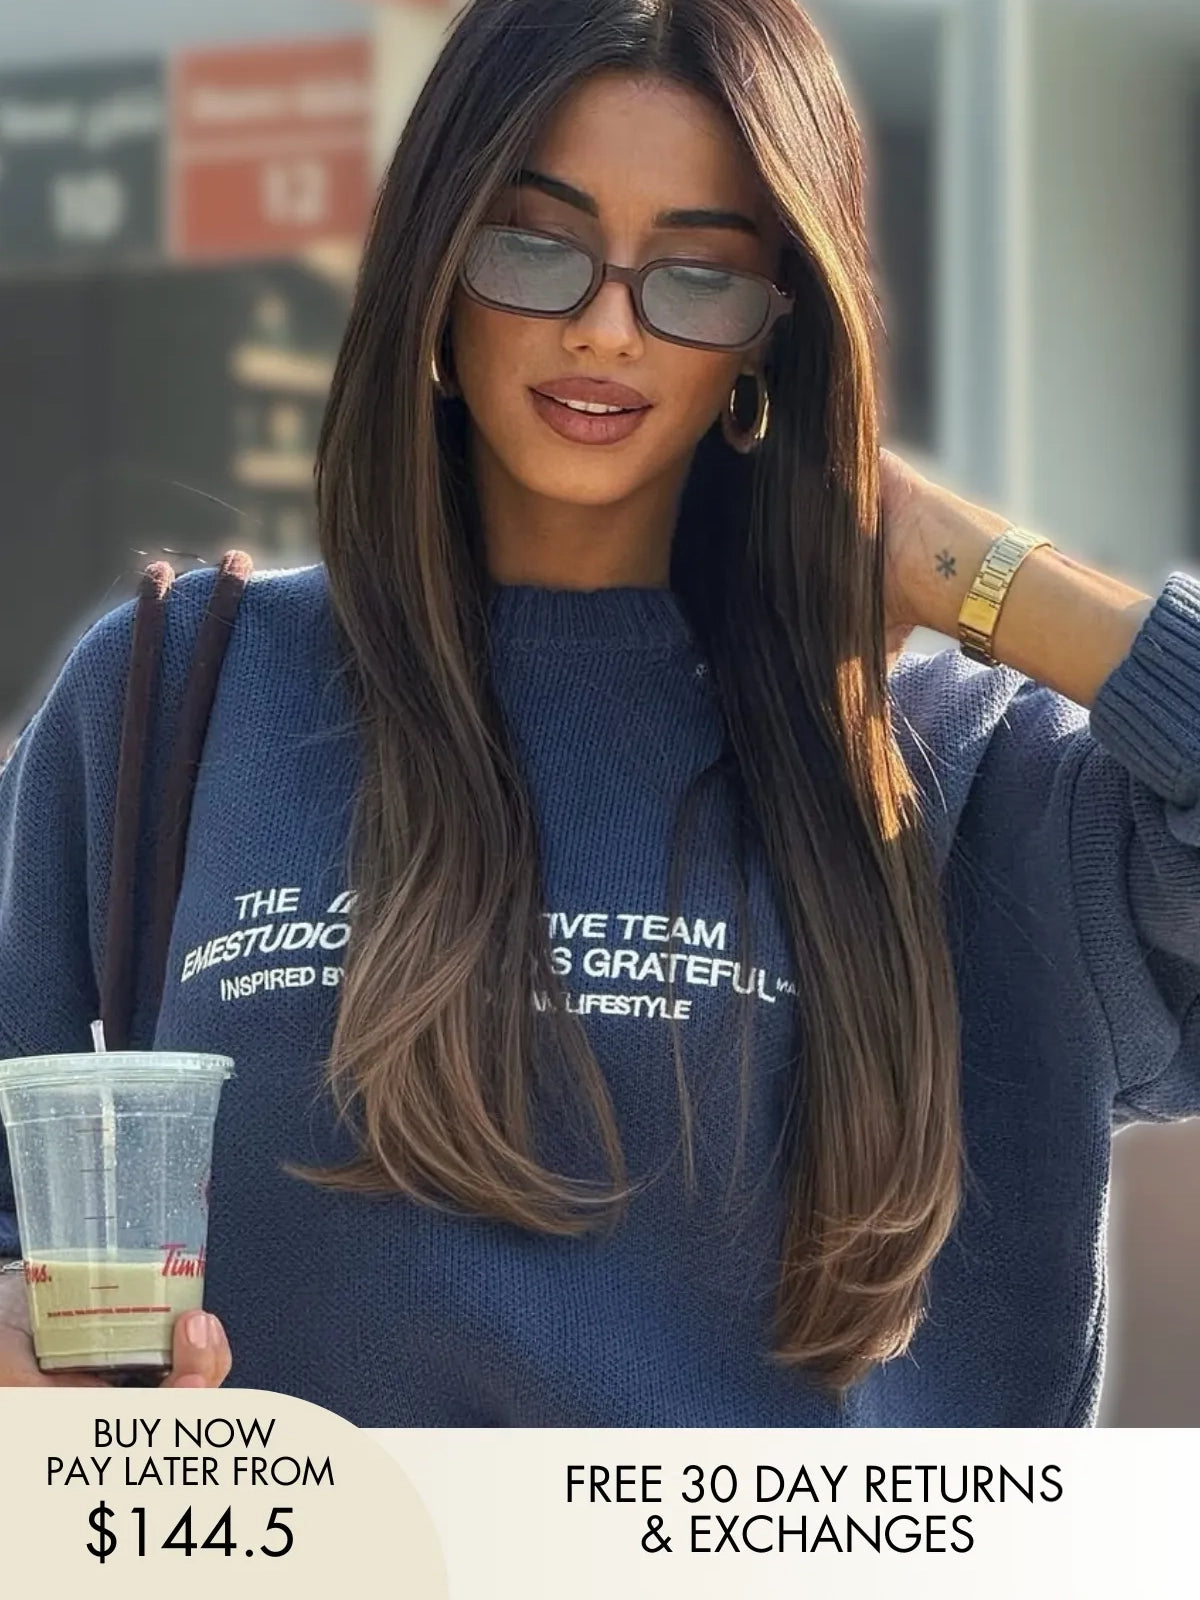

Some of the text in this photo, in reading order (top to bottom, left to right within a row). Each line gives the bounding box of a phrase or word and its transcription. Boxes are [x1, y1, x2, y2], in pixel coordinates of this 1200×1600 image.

[235, 887, 301, 920] THE
[617, 913, 727, 951] TEAM
[220, 966, 316, 1001] INSPIRED
[565, 992, 693, 1020] LIFESTYLE
[583, 947, 776, 1003] GRATEFUL
